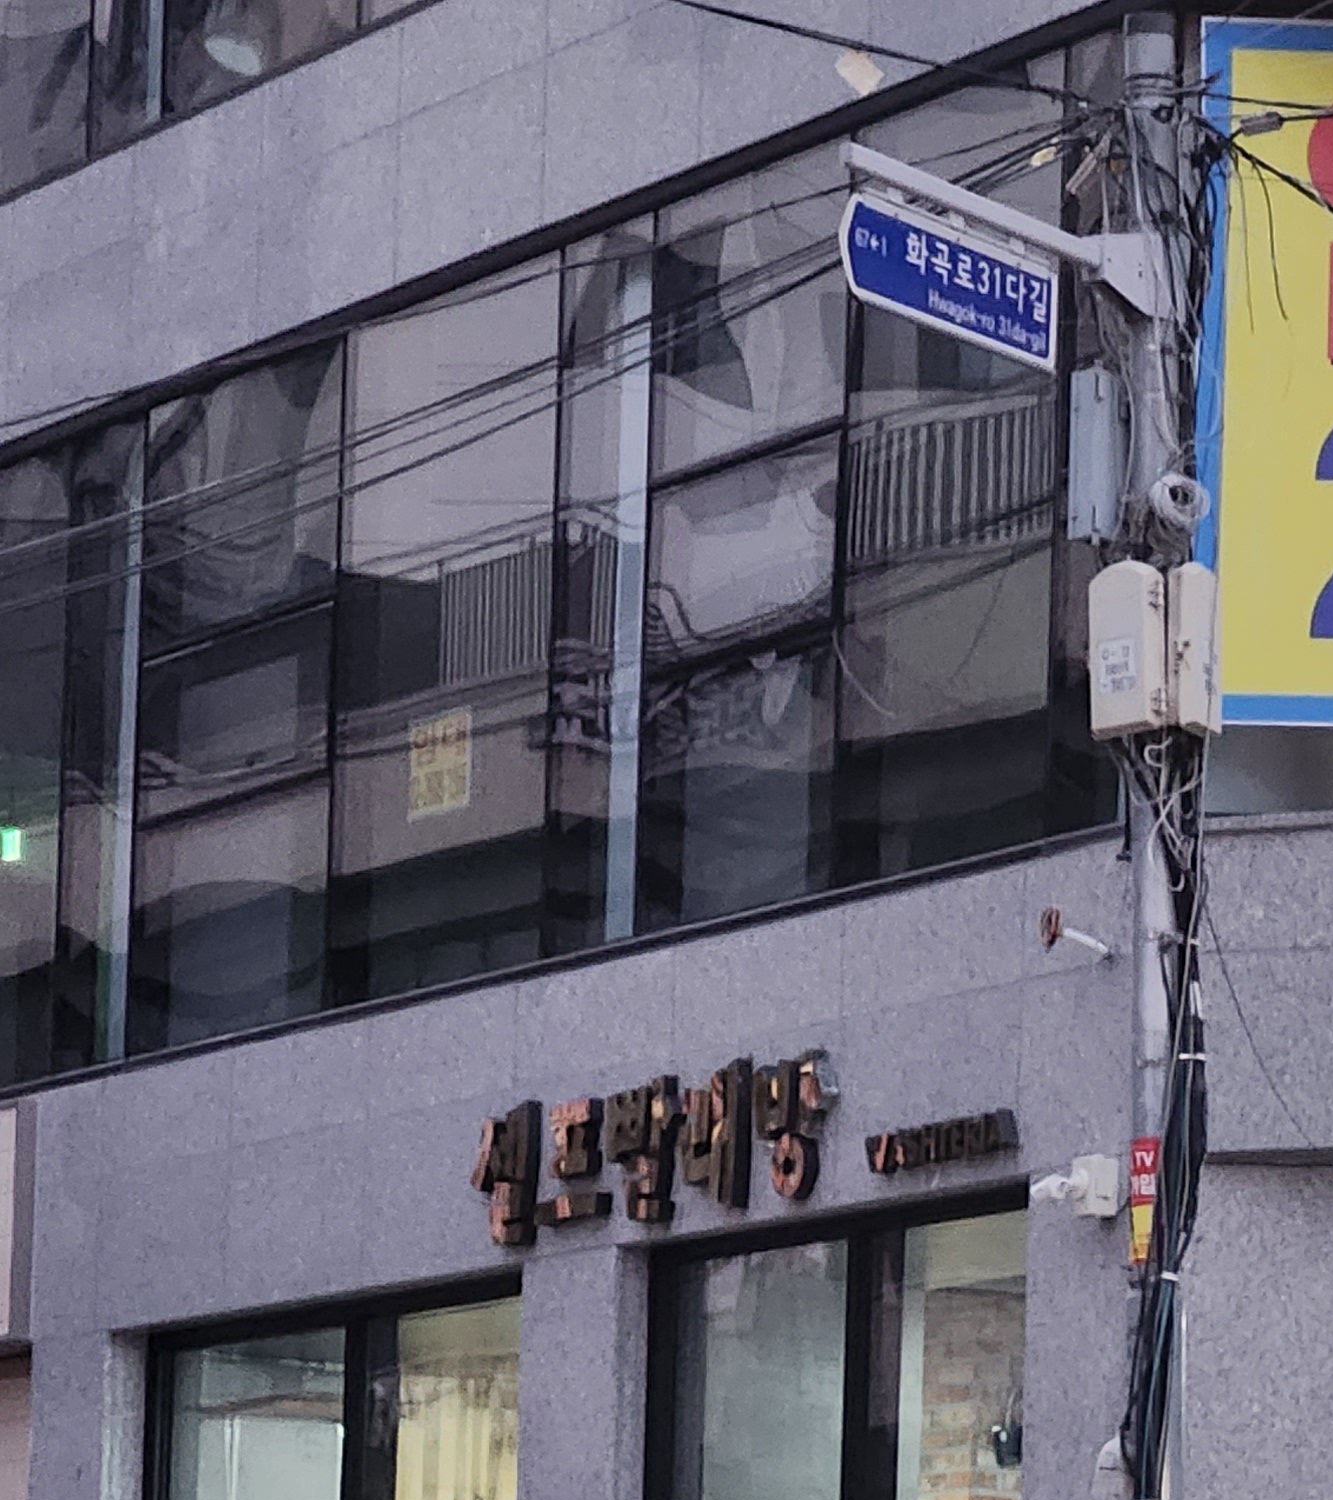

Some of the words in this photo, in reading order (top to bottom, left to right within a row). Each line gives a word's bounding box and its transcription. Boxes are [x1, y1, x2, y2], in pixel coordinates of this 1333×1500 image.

[904, 230, 1048, 323] 화곡로31다길
[927, 287, 996, 333] Hwagok-ro
[1134, 1151, 1155, 1167] TV
